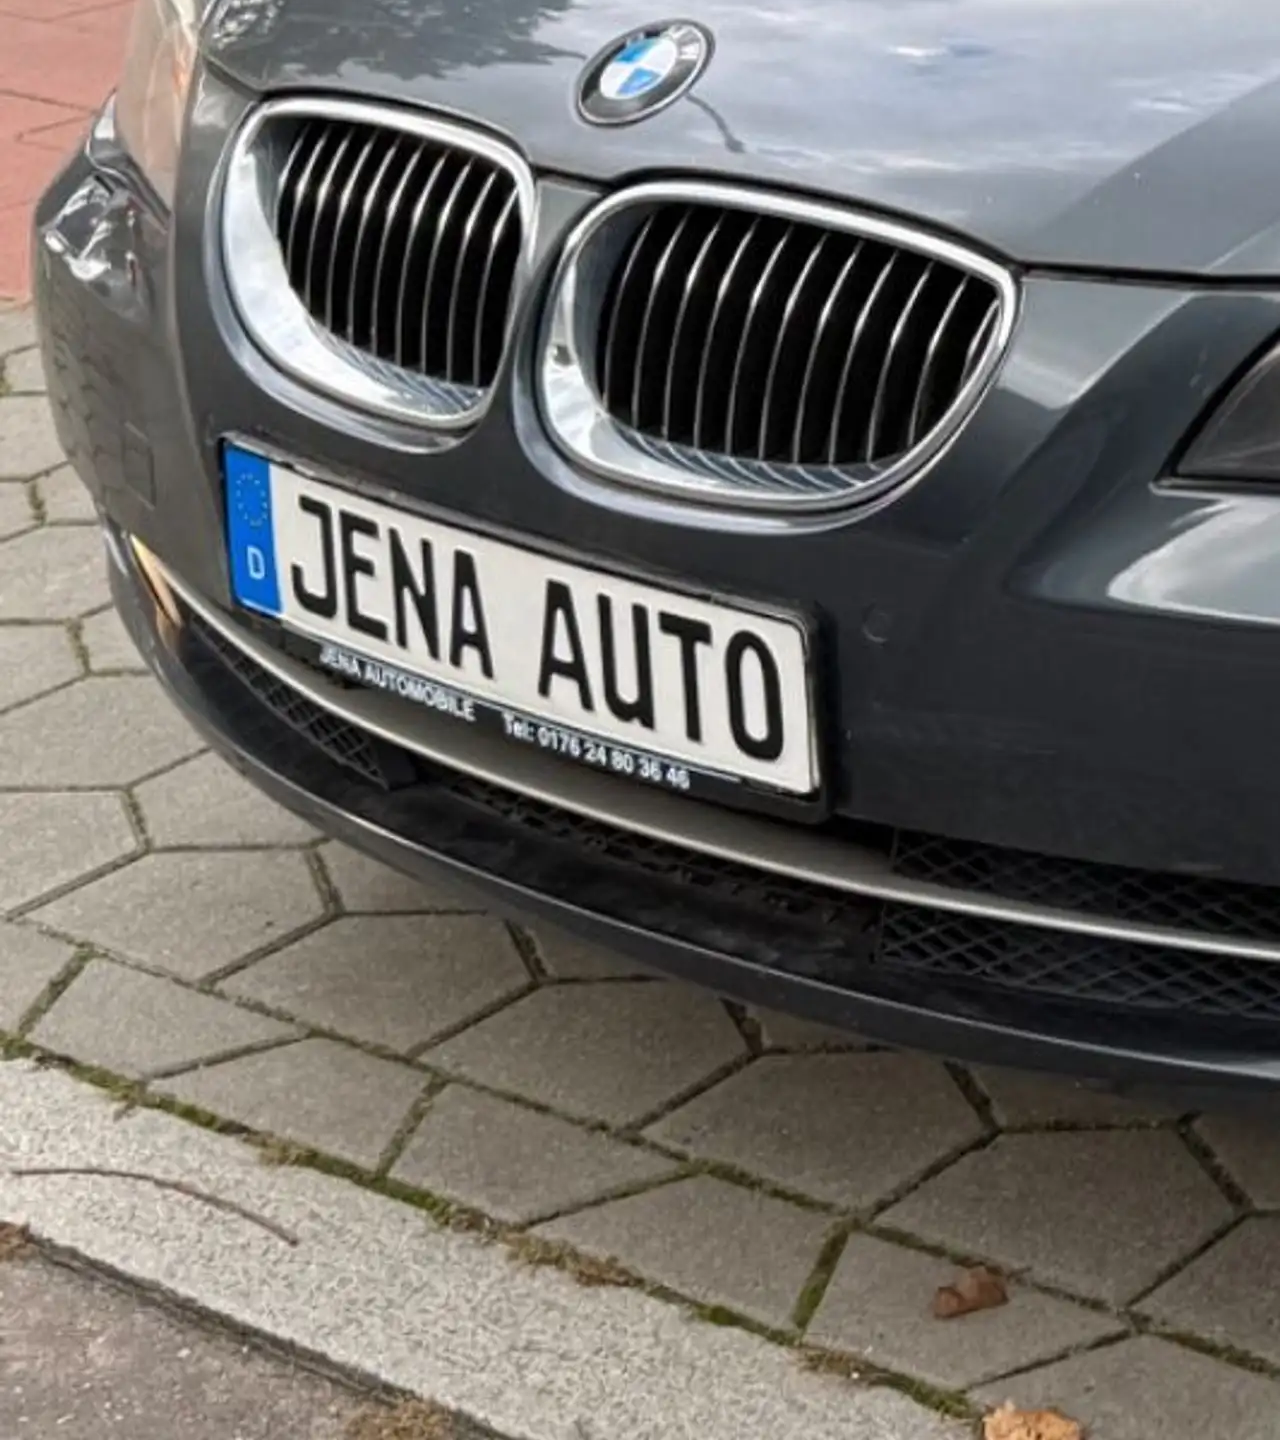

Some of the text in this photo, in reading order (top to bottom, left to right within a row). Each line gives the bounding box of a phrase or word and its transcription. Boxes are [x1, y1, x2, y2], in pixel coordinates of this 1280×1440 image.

[247, 544, 265, 580] D
[291, 493, 785, 762] JENA AUTO
[319, 643, 477, 722] JENA AUTOMOBILE
[537, 725, 580, 758] 0176
[584, 741, 607, 767] 24
